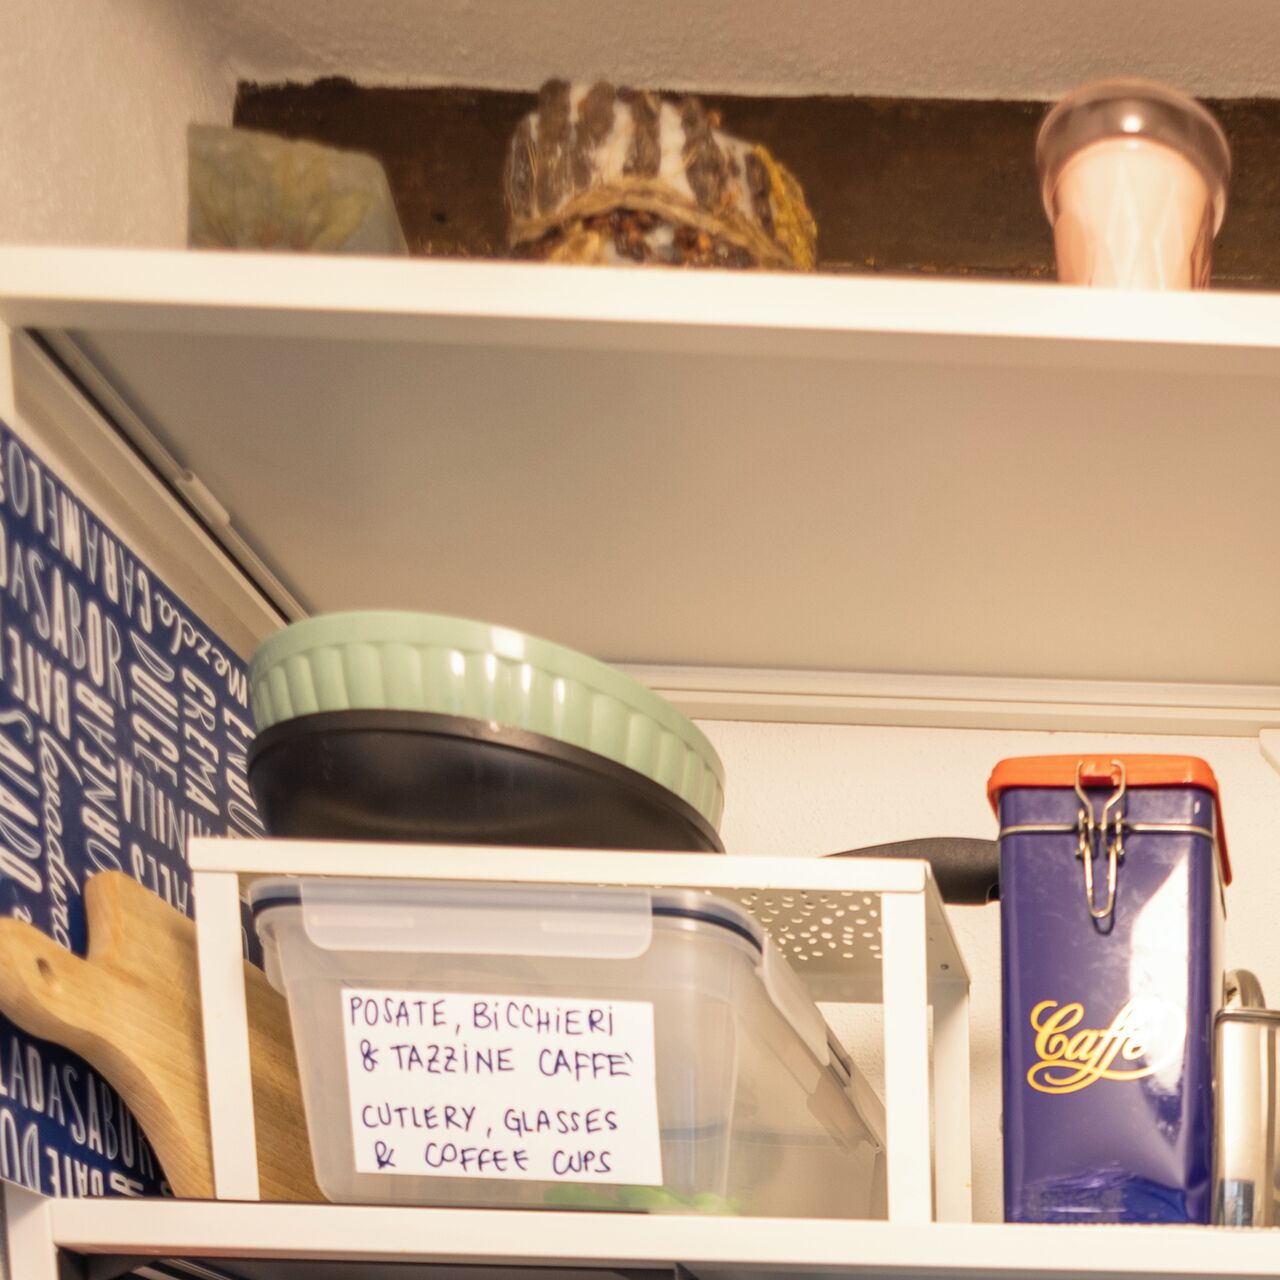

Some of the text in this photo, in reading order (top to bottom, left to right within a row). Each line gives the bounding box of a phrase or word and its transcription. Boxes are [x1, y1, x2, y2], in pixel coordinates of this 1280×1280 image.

[8, 440, 152, 633] CARAMELO
[27, 547, 126, 711] SABOR
[74, 681, 125, 878] ORNEAR
[129, 630, 180, 788] DULCE
[180, 666, 220, 815] CREMA
[360, 1039, 381, 1073] &
[503, 1108, 619, 1139] GLASSES
[374, 1140, 613, 1176] & COFFEE CUPS
